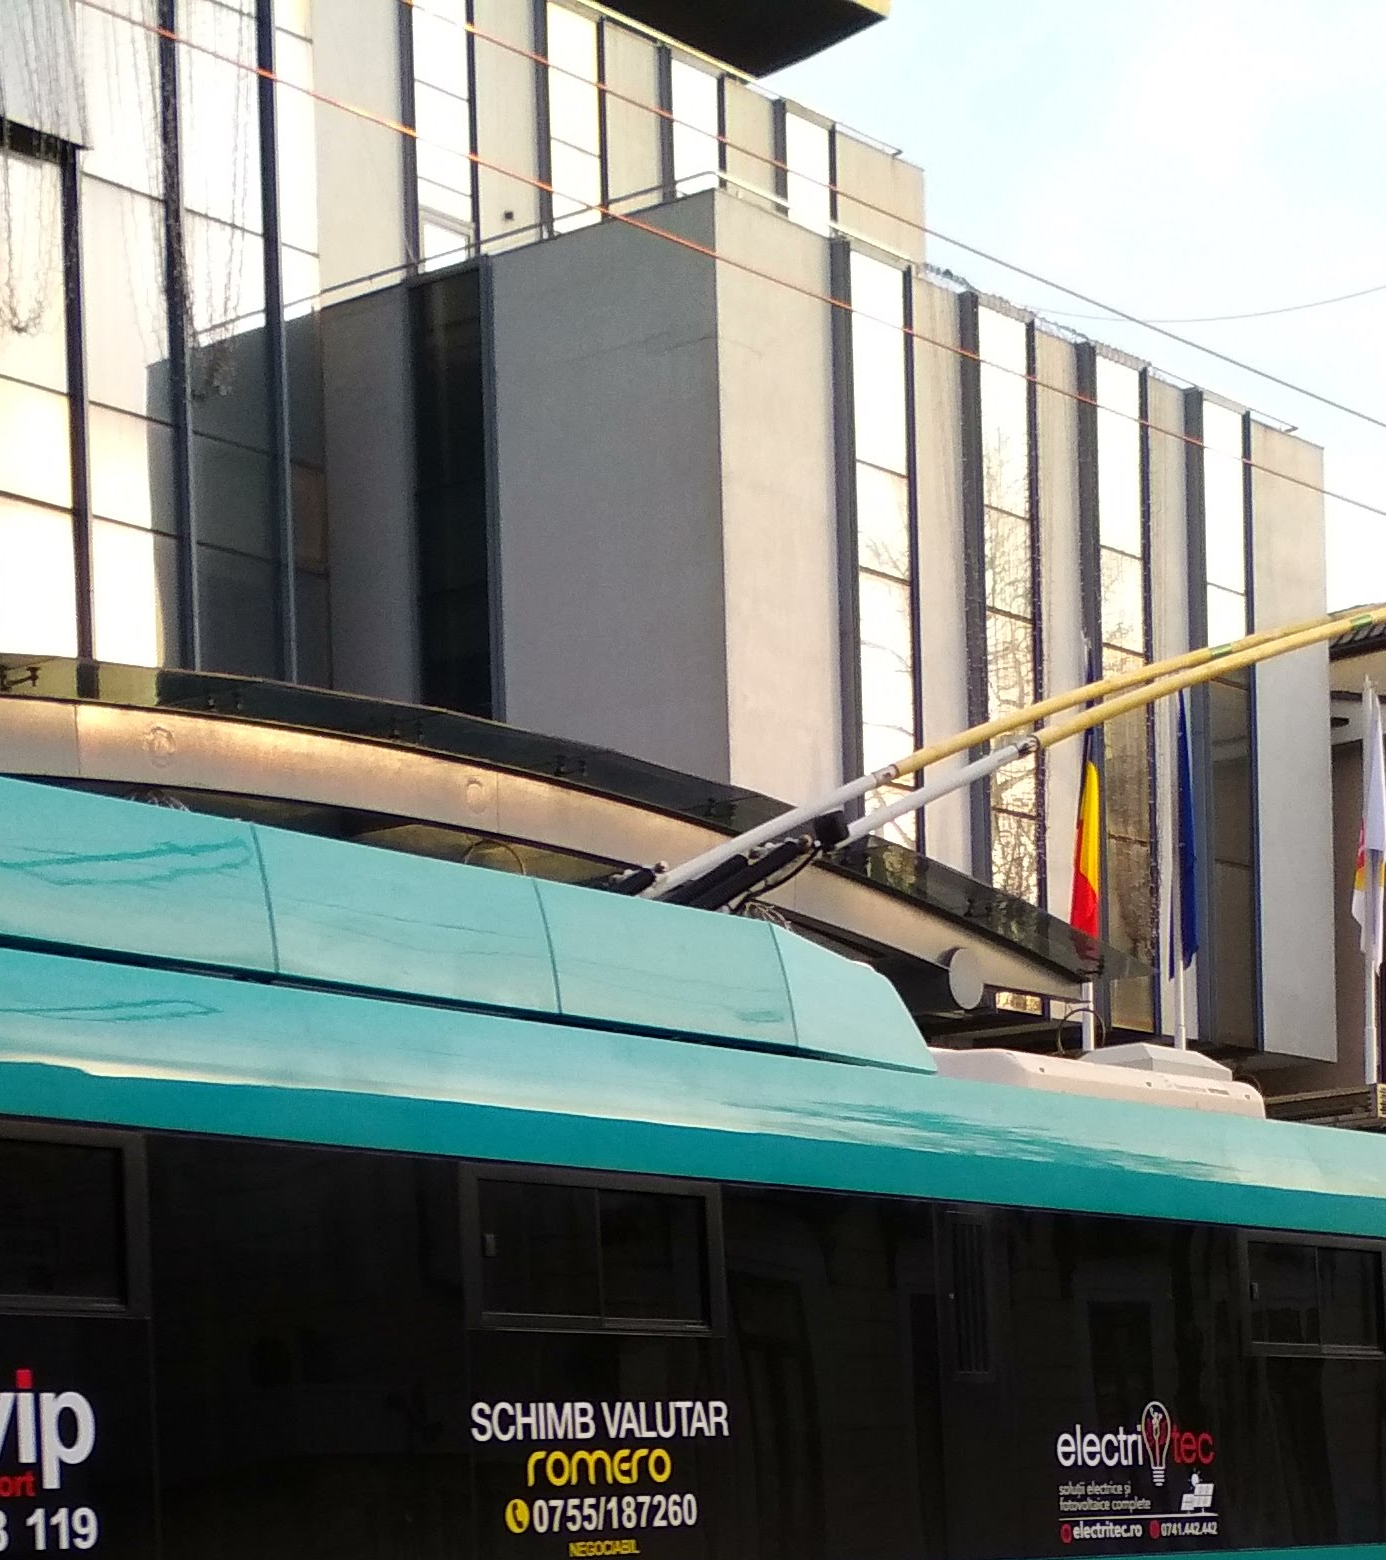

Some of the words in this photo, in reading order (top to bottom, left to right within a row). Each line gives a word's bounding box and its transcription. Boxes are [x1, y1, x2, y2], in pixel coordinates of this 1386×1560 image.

[471, 1402, 596, 1441] SCHIMB
[601, 1401, 729, 1438] VALUTAR
[527, 1448, 671, 1486] romero
[533, 1494, 697, 1533] 0755/187260
[1112, 1496, 1151, 1513] complete
[26, 1506, 99, 1551] 119
[1073, 1521, 1142, 1538] electritec.ro
